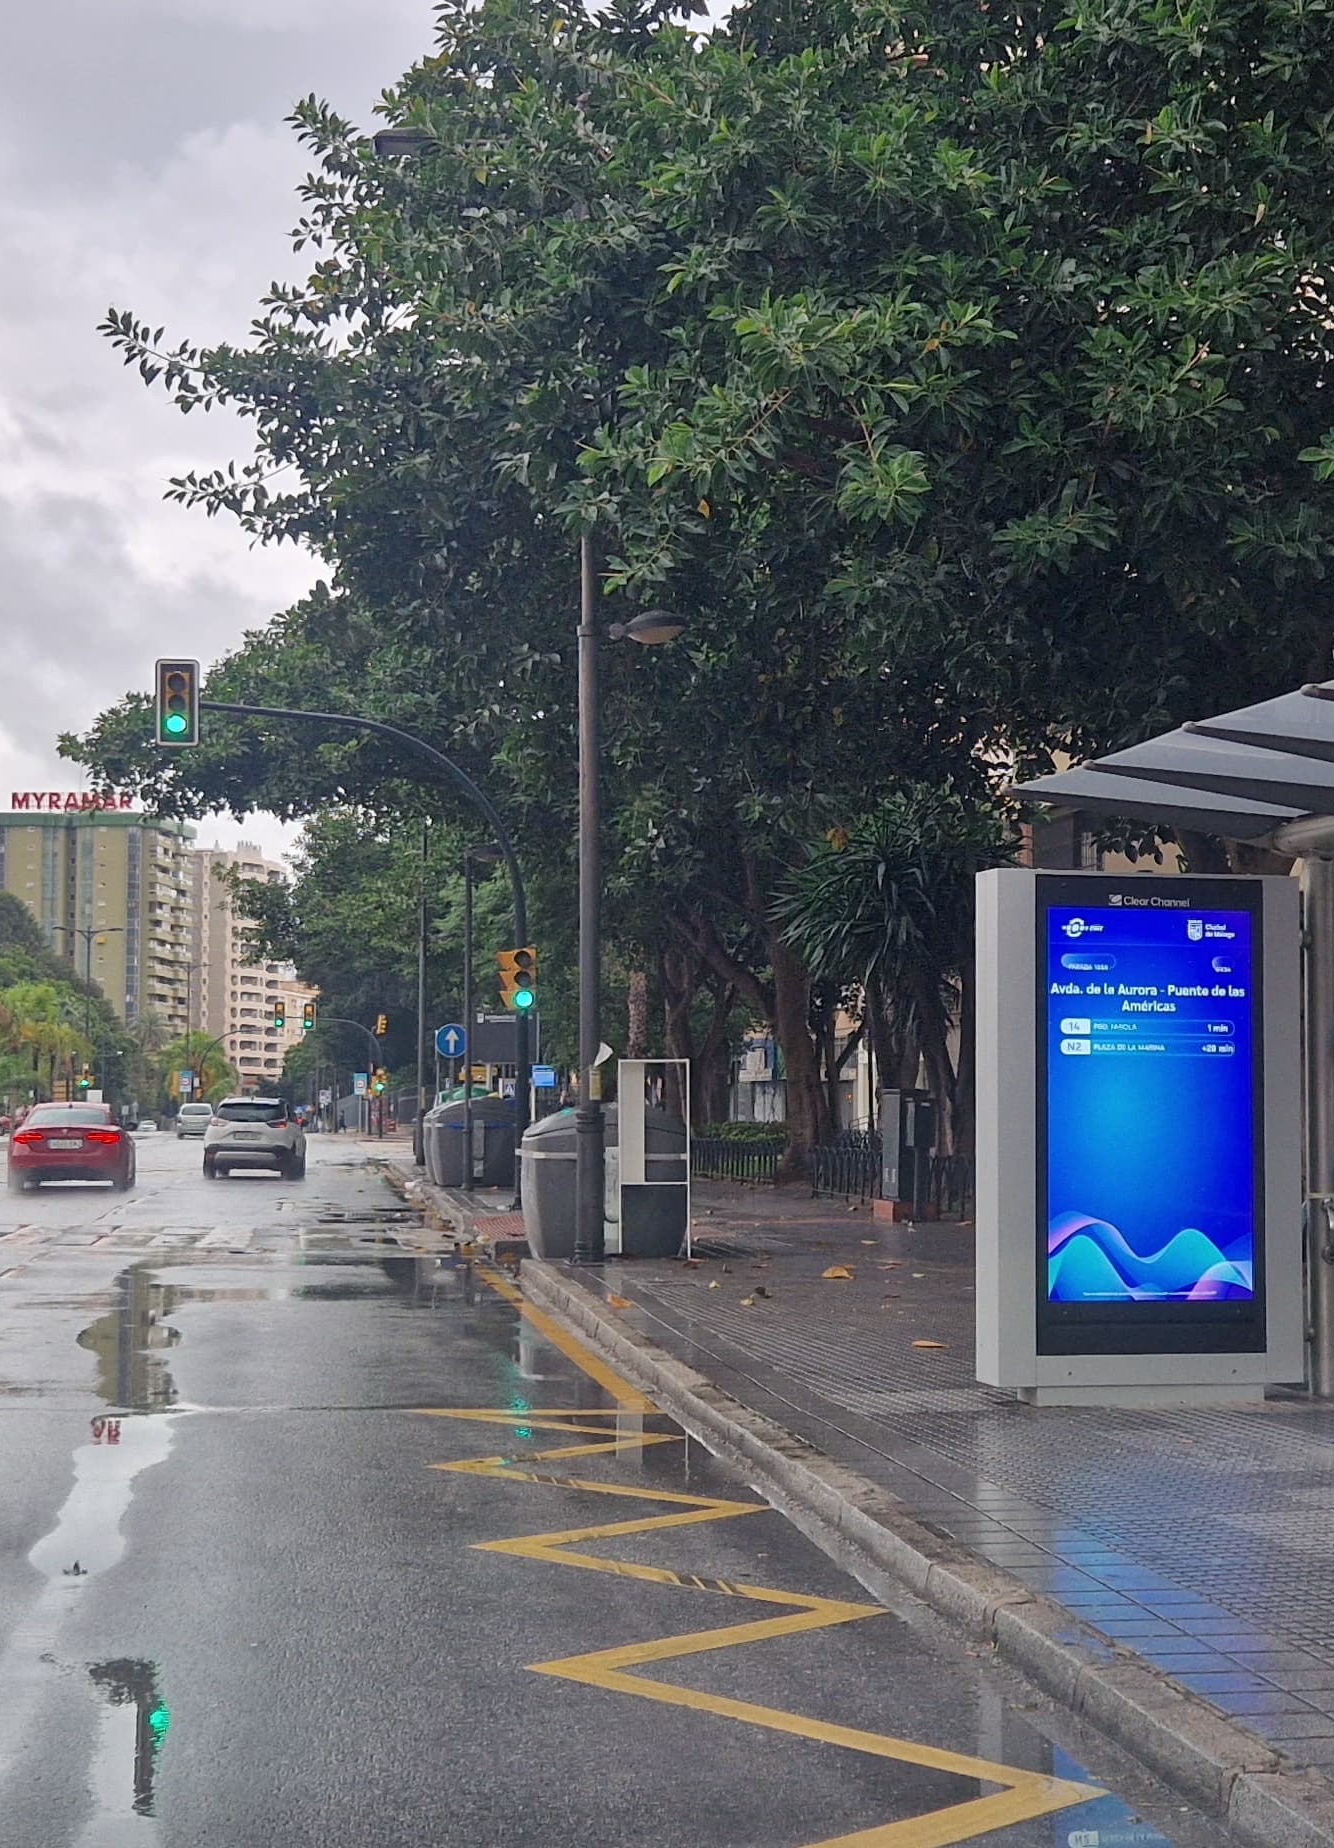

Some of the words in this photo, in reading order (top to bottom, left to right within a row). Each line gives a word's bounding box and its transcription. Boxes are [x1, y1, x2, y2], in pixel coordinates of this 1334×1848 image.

[11, 792, 133, 810] MYRAMAR
[1124, 897, 1149, 906] Clear
[1151, 897, 1190, 907] Channel
[1051, 983, 1083, 994] Avda.
[1087, 983, 1101, 995] de
[1104, 983, 1114, 995] la
[1118, 984, 1158, 996] Aurora
[1168, 985, 1208, 996] Puente
[1211, 985, 1226, 997] de
[1228, 985, 1245, 997] las
[1122, 1000, 1176, 1012] Américas
[1069, 1022, 1080, 1031] 14
[1208, 1024, 1212, 1032] 1
[1213, 1024, 1228, 1033] min
[1067, 1042, 1082, 1051] N2
